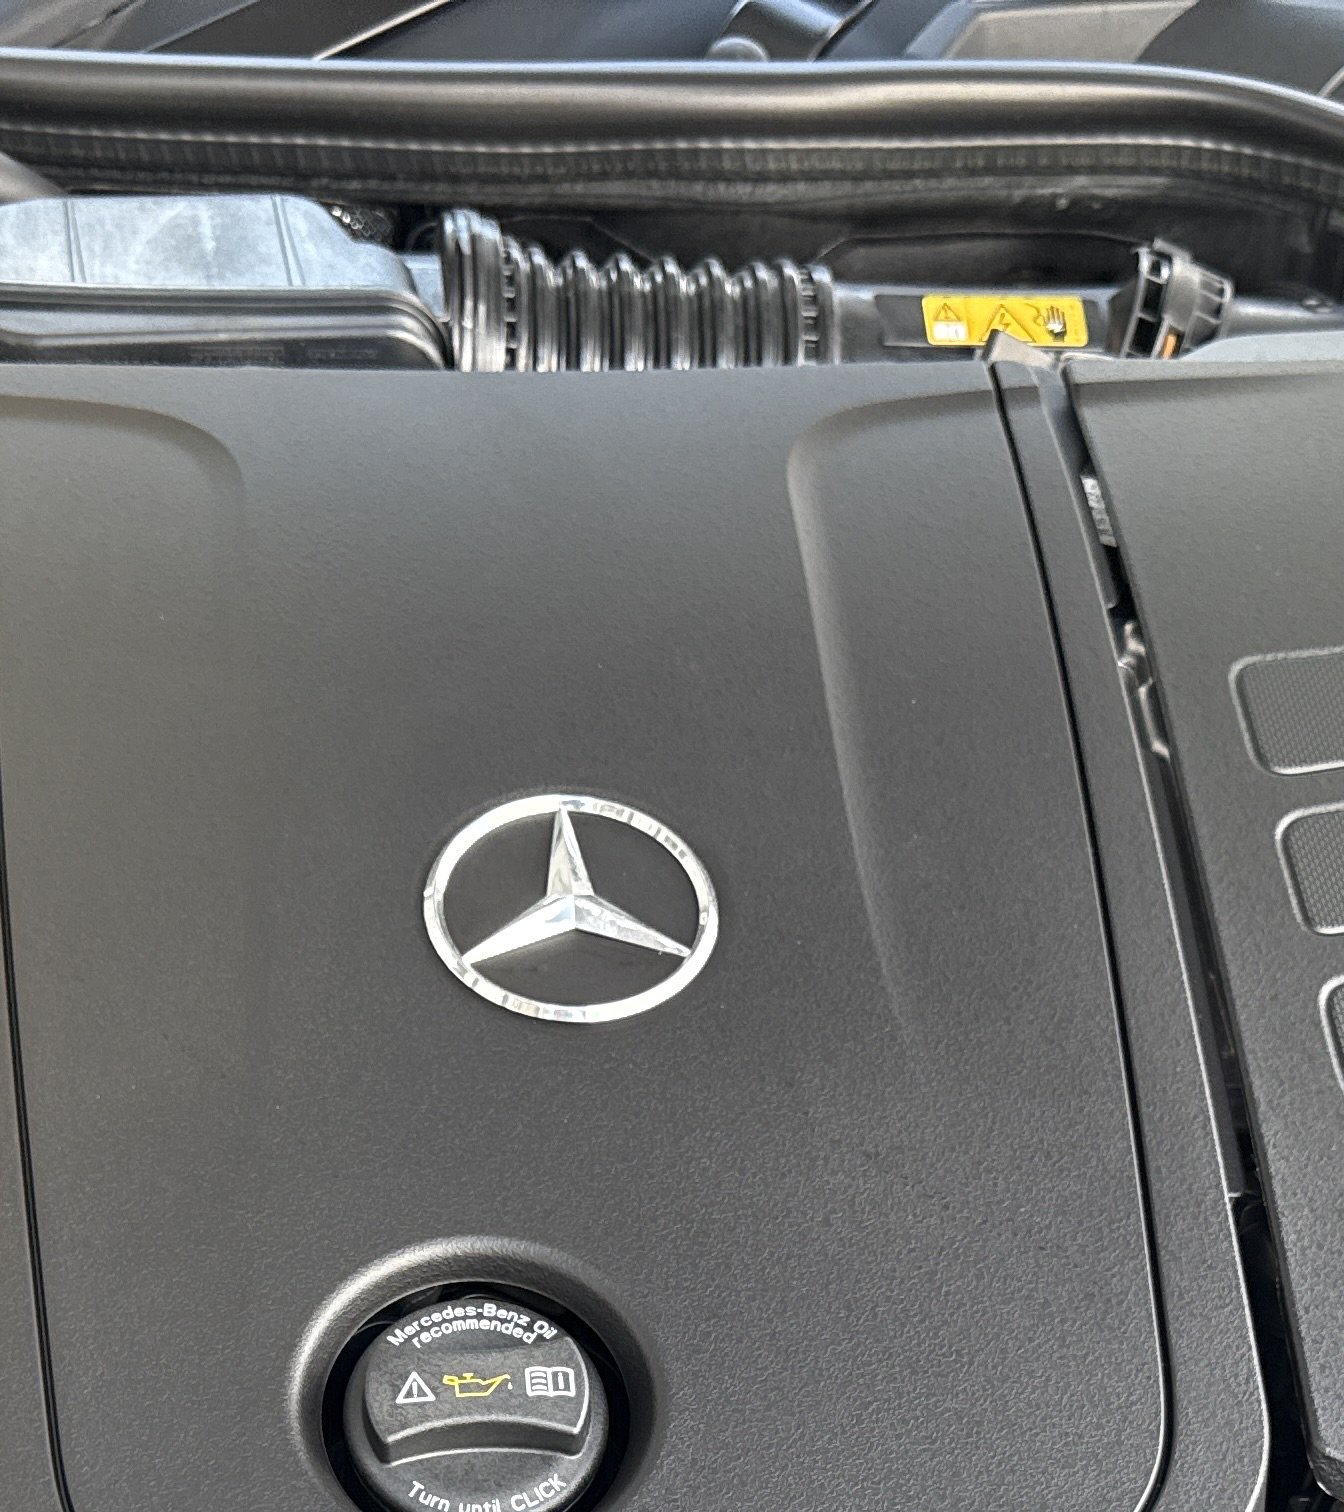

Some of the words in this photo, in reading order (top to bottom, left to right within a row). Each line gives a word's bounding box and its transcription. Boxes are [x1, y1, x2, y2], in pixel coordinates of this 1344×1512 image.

[386, 1303, 531, 1346] Mercedes-Benz
[533, 1320, 558, 1340] Oil
[411, 1318, 538, 1349] recommended
[408, 1480, 451, 1512] Turn
[510, 1473, 567, 1512] CLICK
